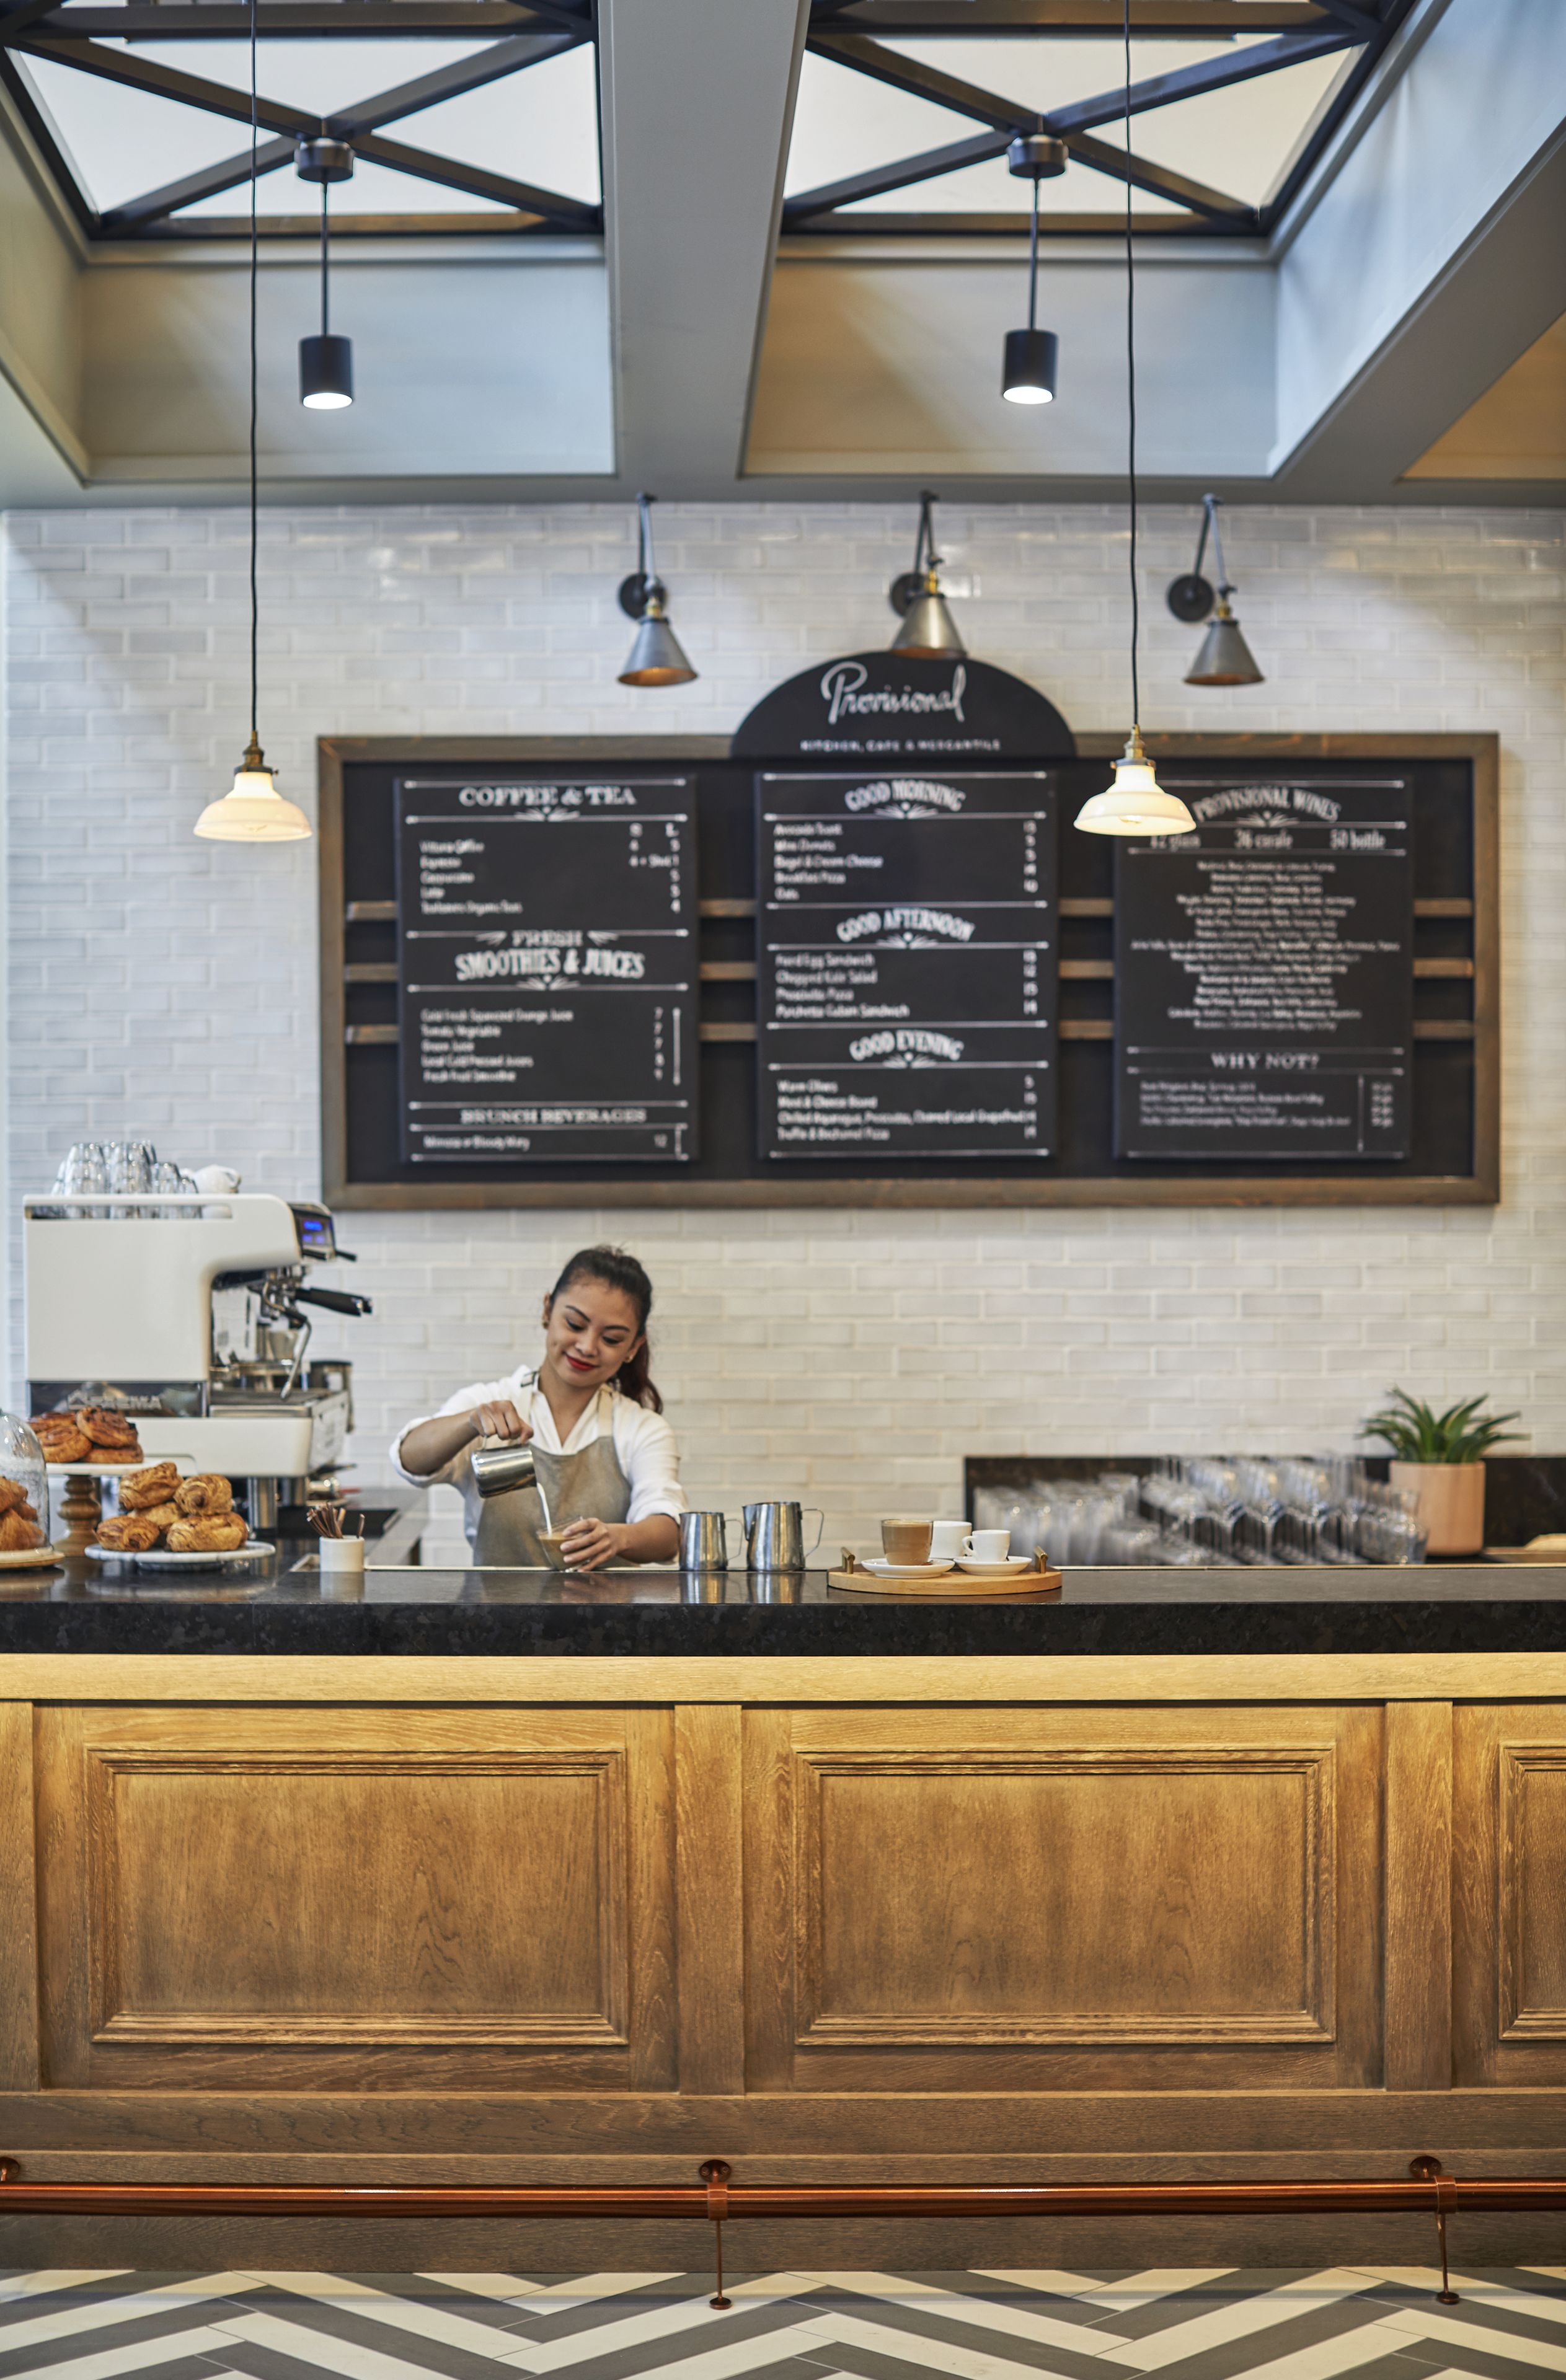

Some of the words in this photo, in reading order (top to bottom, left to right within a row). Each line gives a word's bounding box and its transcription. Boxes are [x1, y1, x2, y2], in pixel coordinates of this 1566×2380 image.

[819, 661, 966, 724] Provisional
[458, 785, 557, 808] COFFEE
[561, 788, 582, 805] &
[585, 786, 636, 805] TEA
[845, 782, 891, 813] GOOD
[891, 780, 965, 813] MORNING
[1192, 787, 1290, 824] PROVISIONAL
[1293, 789, 1340, 824] WINES
[512, 930, 582, 948] FRESH
[837, 912, 882, 943] GOOD
[883, 907, 975, 943] AFTERNOON
[455, 948, 561, 981] SMOOTHIES
[582, 948, 644, 978] JUICES
[849, 1031, 895, 1062] GOOD
[896, 1030, 964, 1062] EVENING
[1211, 1053, 1257, 1069] WHY
[1265, 1053, 1319, 1069] NOT?
[461, 1109, 537, 1124] BRUNCH
[541, 1109, 646, 1124] BEVERAGES
